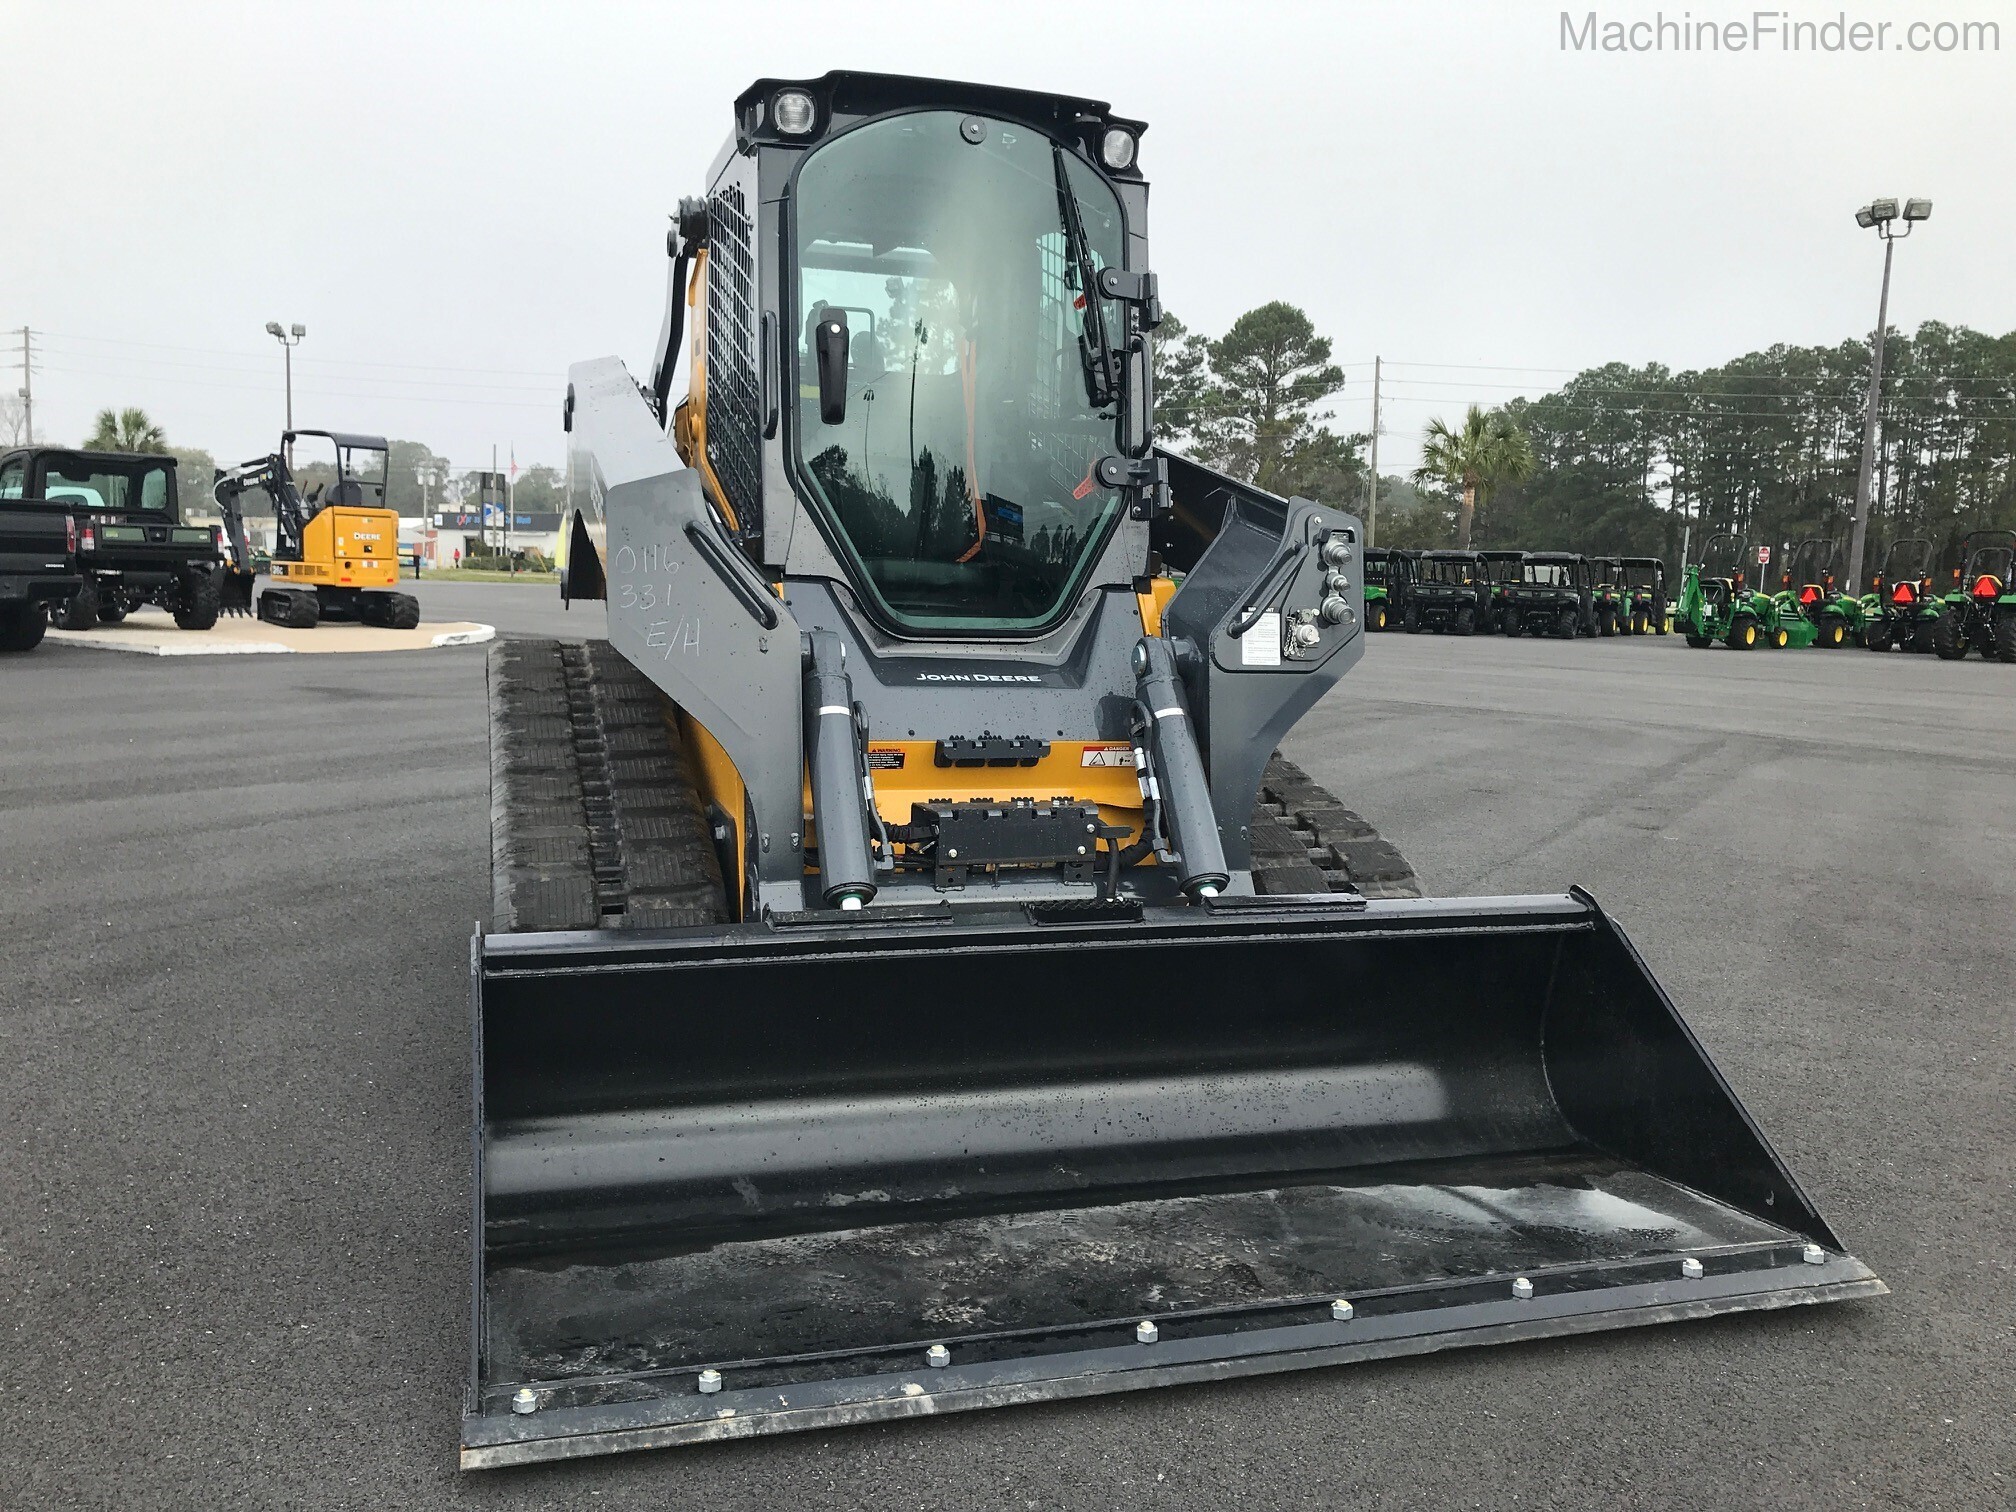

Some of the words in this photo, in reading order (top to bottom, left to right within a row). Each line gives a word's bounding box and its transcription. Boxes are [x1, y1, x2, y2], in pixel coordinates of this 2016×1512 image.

[353, 532, 381, 540] DEERE
[620, 584, 672, 610] 331
[646, 614, 700, 661] E/H
[916, 673, 970, 682] JOHN
[972, 674, 1042, 682] DEERE
